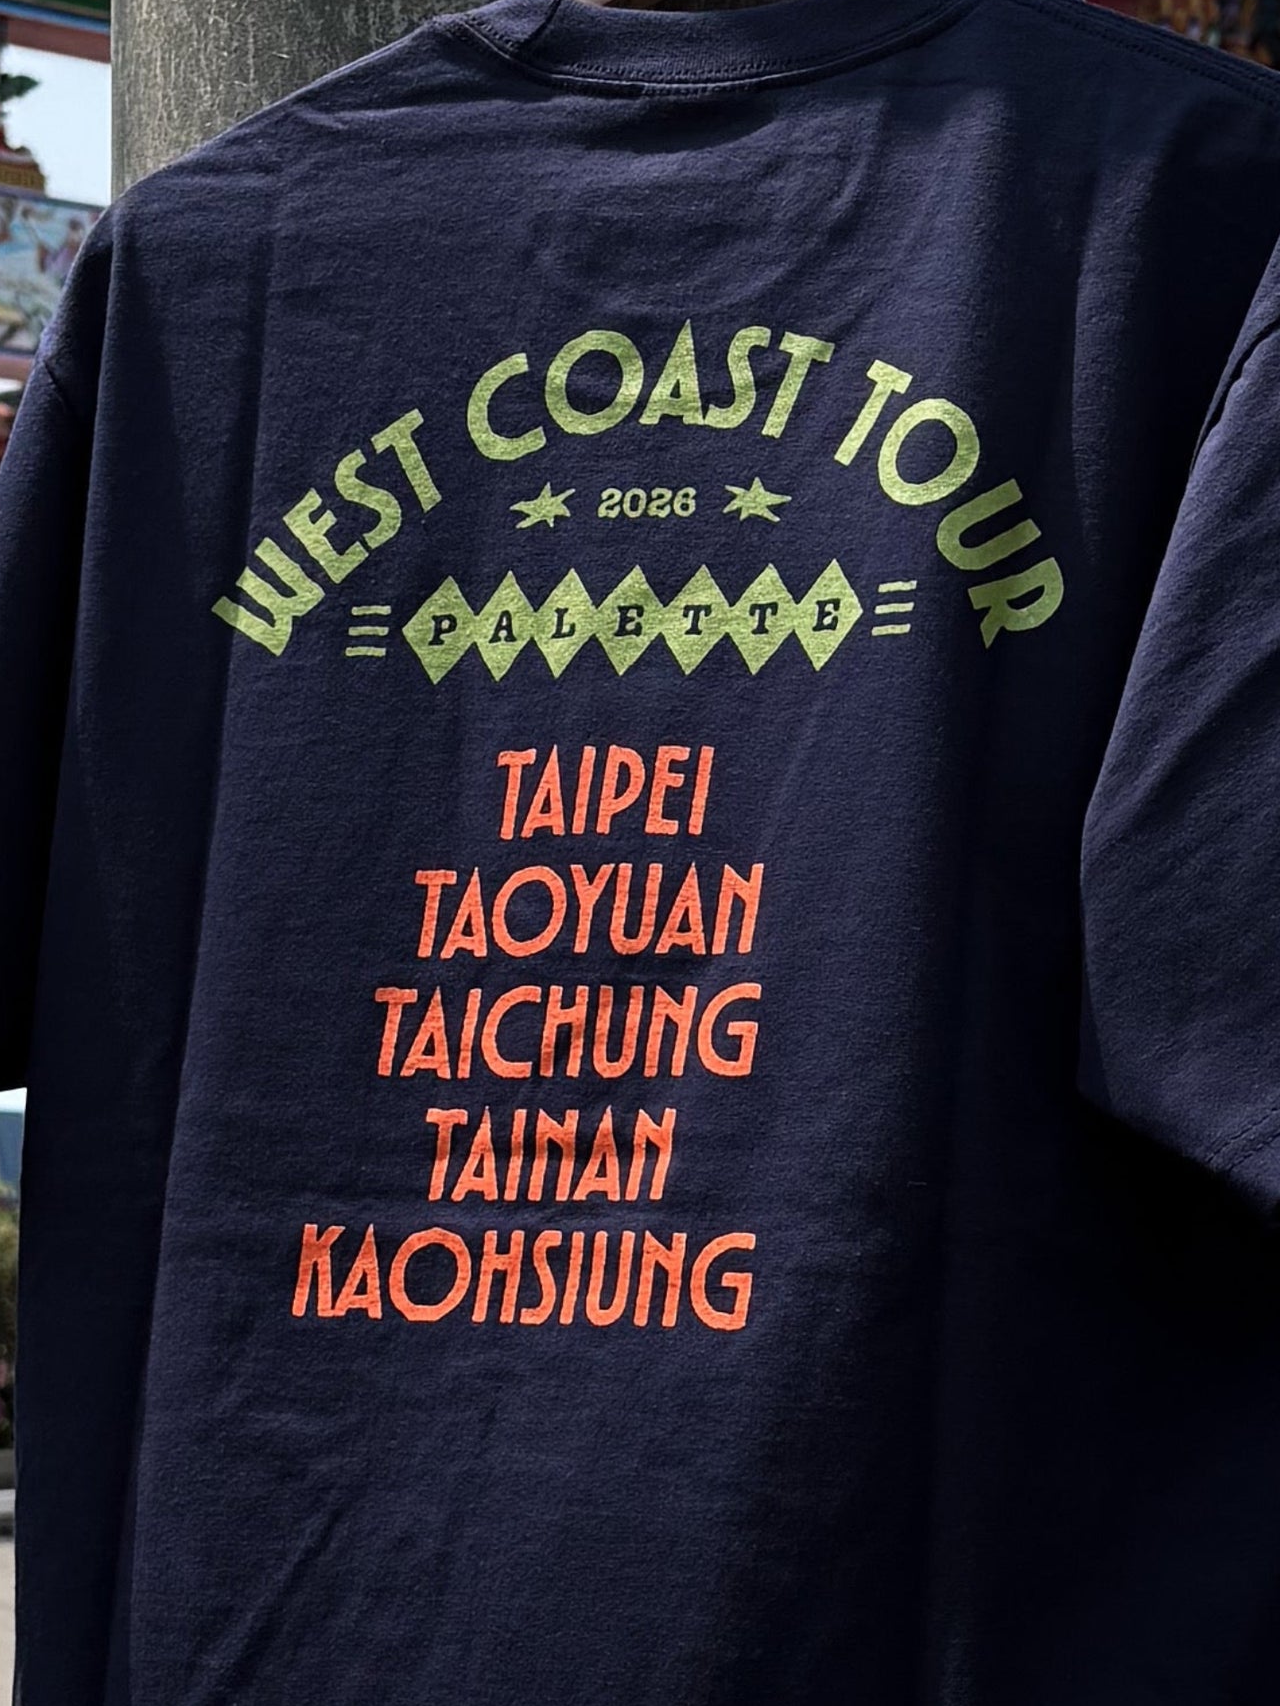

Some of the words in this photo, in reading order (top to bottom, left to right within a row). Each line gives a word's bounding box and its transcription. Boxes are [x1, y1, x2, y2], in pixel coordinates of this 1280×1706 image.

[211, 409, 443, 657] WEST
[466, 319, 835, 462] COAST
[834, 359, 1065, 649] TOUR
[596, 486, 698, 521] 2026
[426, 598, 846, 648] PALETTE
[497, 744, 715, 841] TAIPEI
[414, 862, 765, 960] TAOYUAN
[374, 982, 762, 1080] TAICHUNG
[425, 1106, 677, 1202] TAINAN
[291, 1223, 756, 1332] KAOHSIUNG
